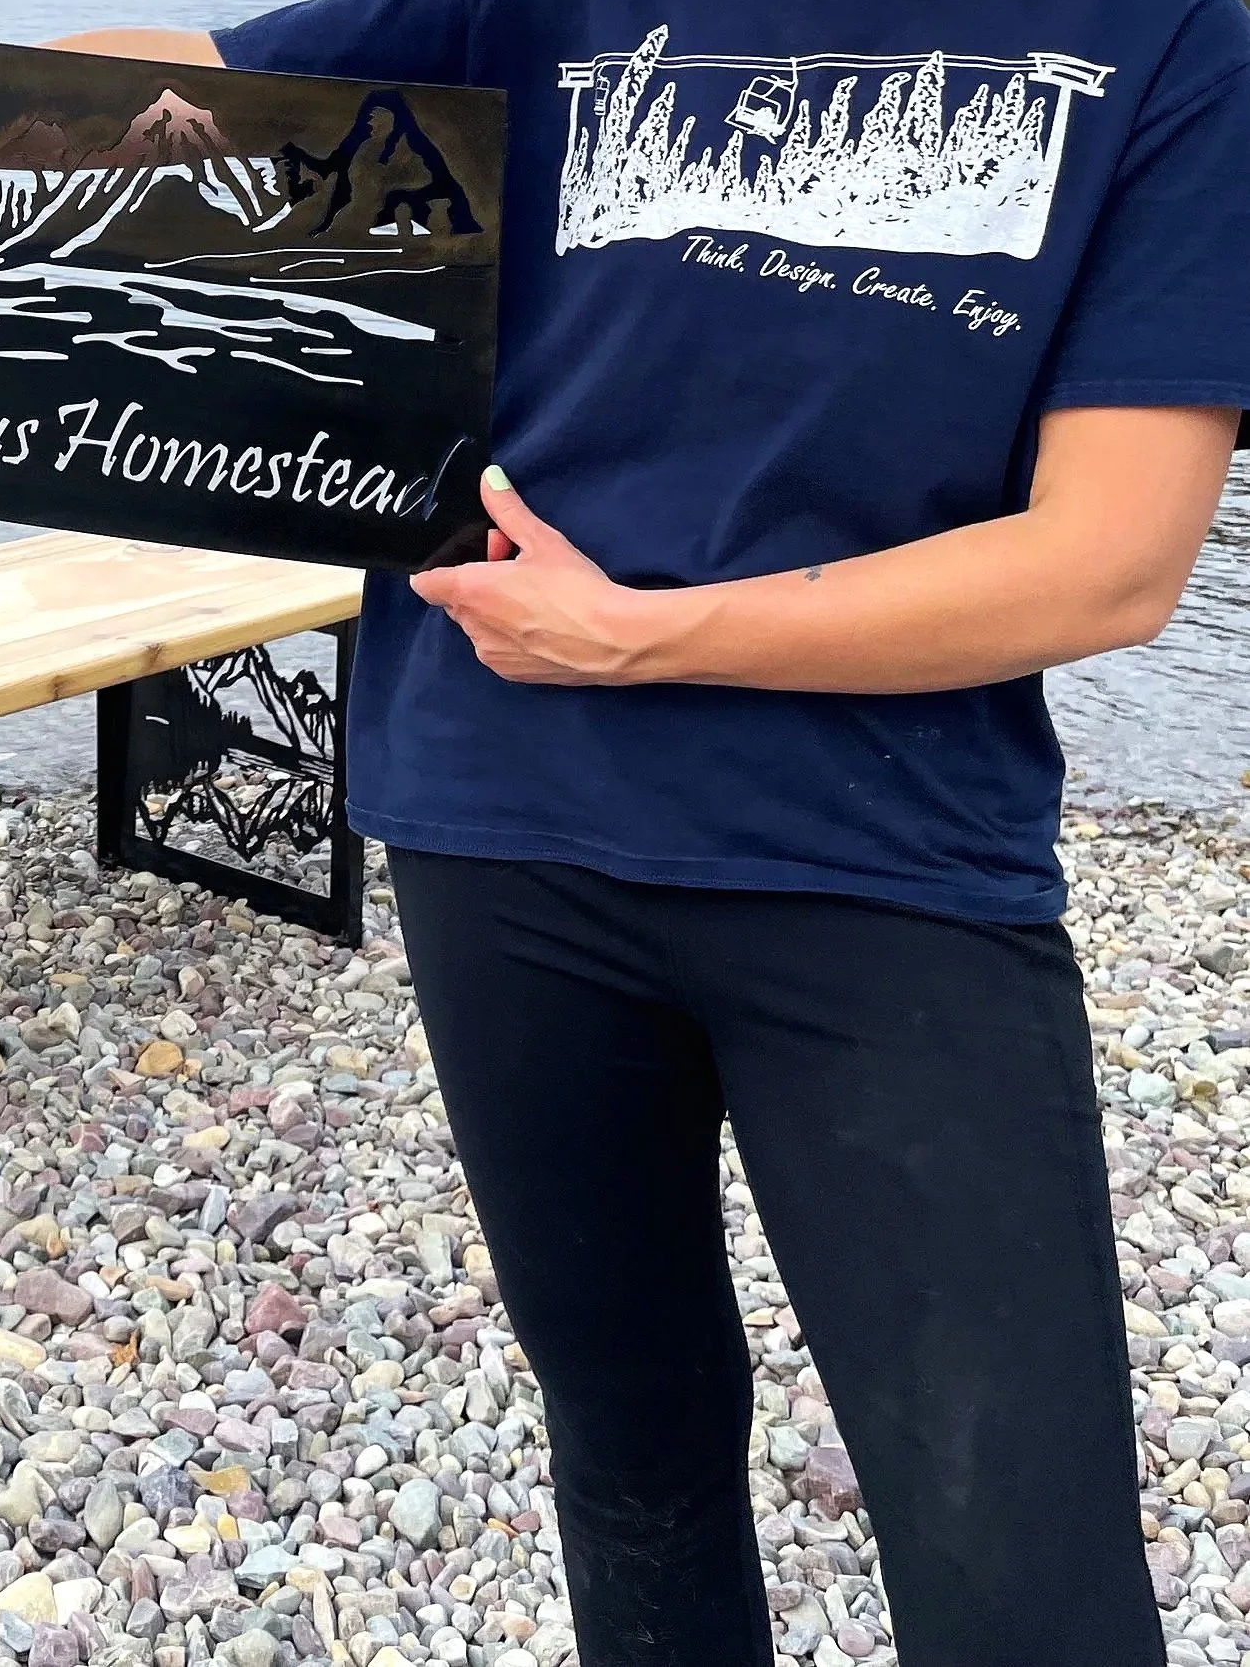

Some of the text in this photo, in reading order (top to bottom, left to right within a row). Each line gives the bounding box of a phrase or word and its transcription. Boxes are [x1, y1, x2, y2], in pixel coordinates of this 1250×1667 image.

[681, 234, 1022, 337] Think. Design. Create. Enjoy.
[55, 398, 473, 521] Homestead
